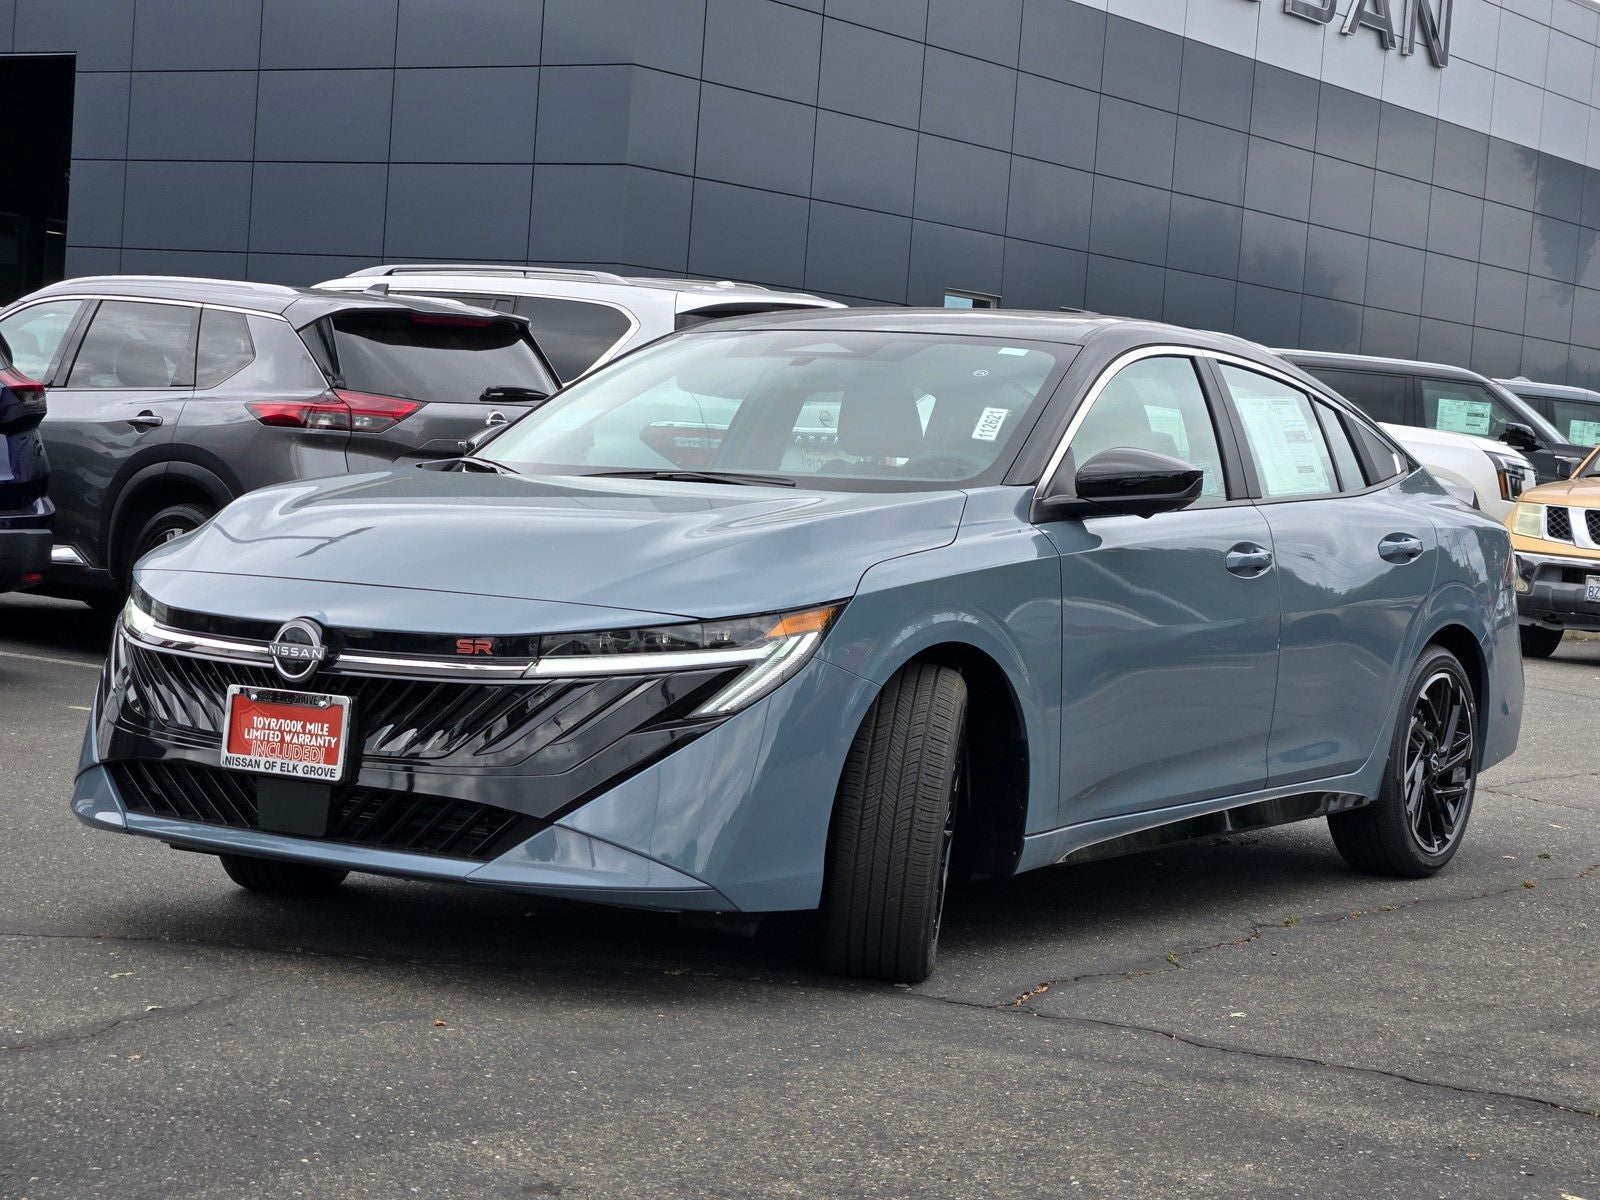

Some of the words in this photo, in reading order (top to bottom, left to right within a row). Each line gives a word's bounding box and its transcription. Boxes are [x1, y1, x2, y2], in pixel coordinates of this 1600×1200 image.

[978, 410, 1005, 438] 112621
[269, 644, 323, 659] NISSAN
[456, 638, 493, 655] SR
[253, 716, 304, 733] 10YR/100K
[305, 721, 330, 736] MILE
[244, 728, 281, 743] LIMITED
[283, 731, 338, 748] WARRANTY
[250, 740, 326, 764] INCLUDED!
[224, 755, 261, 769] NISSAN
[263, 760, 278, 771] OF
[280, 762, 299, 774] ELK
[301, 765, 337, 778] GROVE
